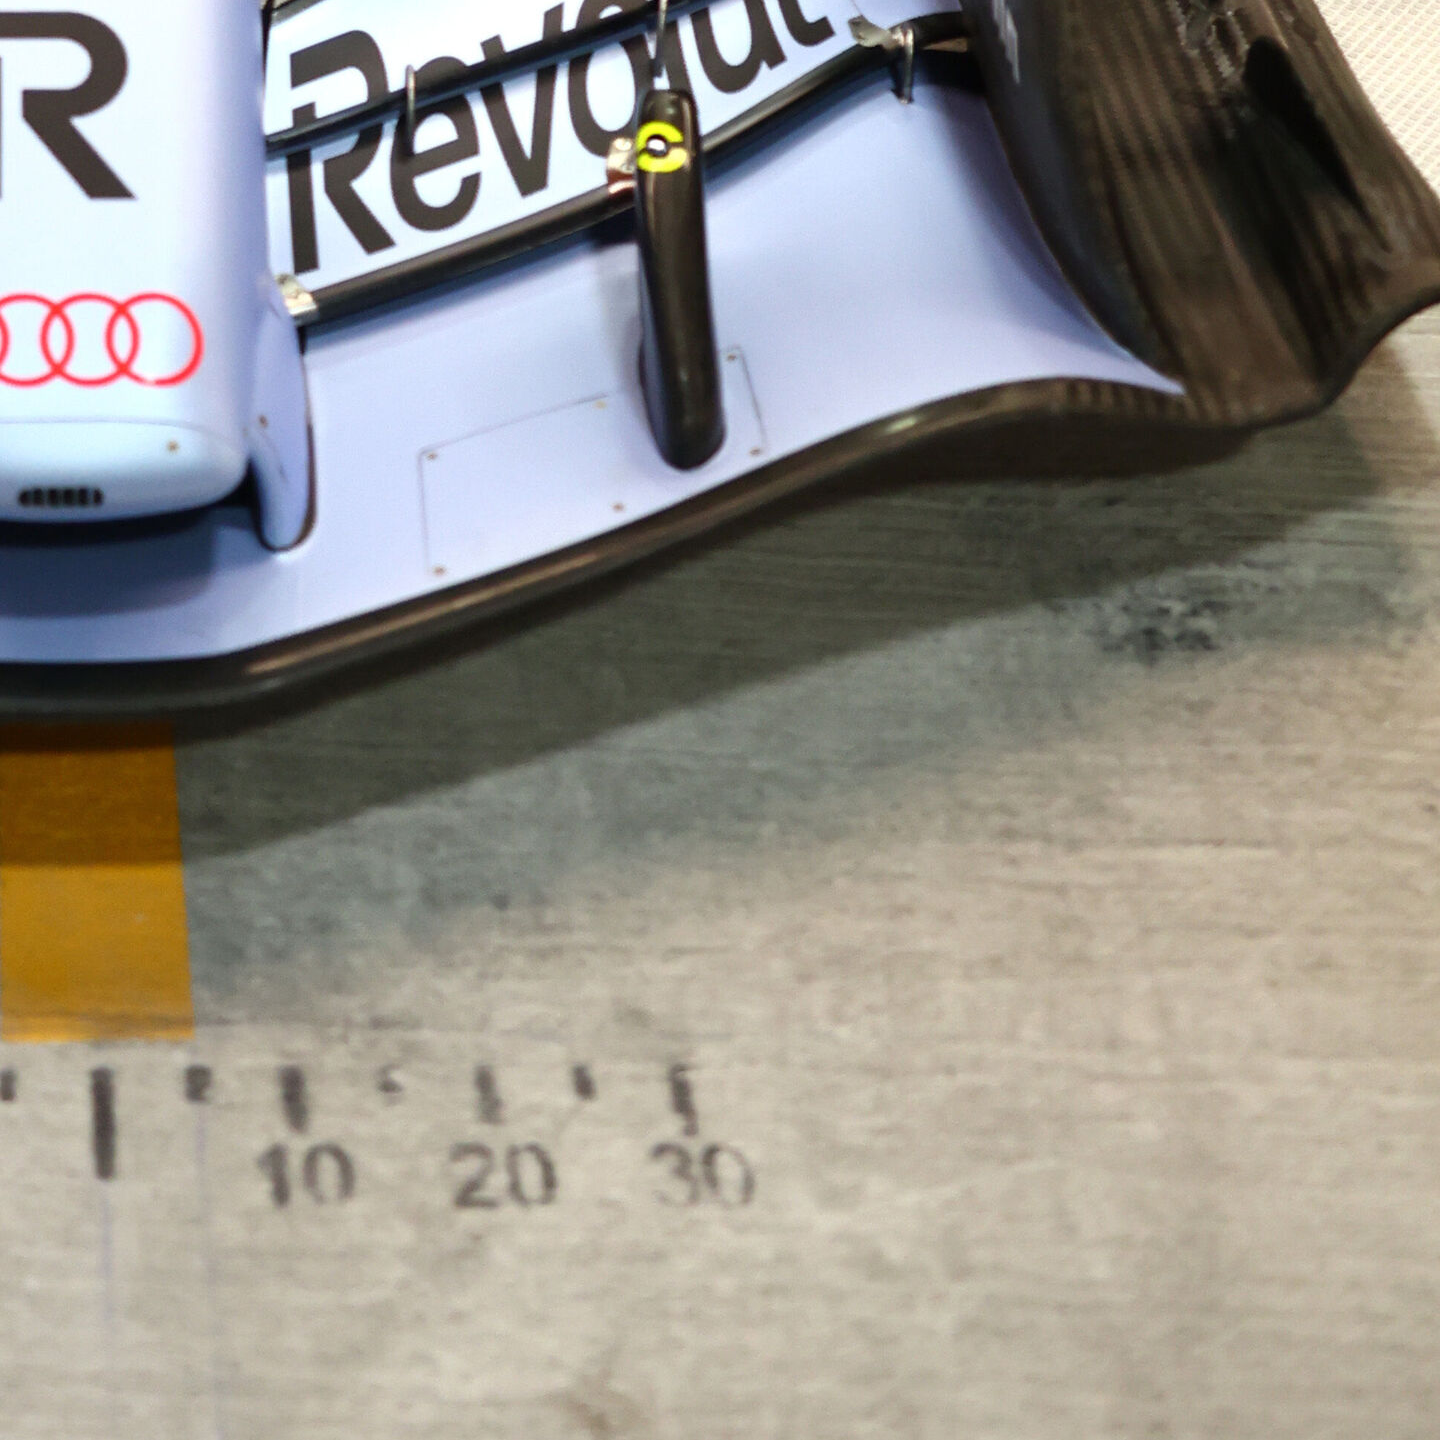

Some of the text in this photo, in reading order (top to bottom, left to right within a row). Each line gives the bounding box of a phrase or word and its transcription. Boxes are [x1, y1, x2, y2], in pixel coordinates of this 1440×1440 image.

[257, 1146, 356, 1210] 10
[452, 1145, 558, 1210] 20
[650, 1148, 756, 1210] 30
